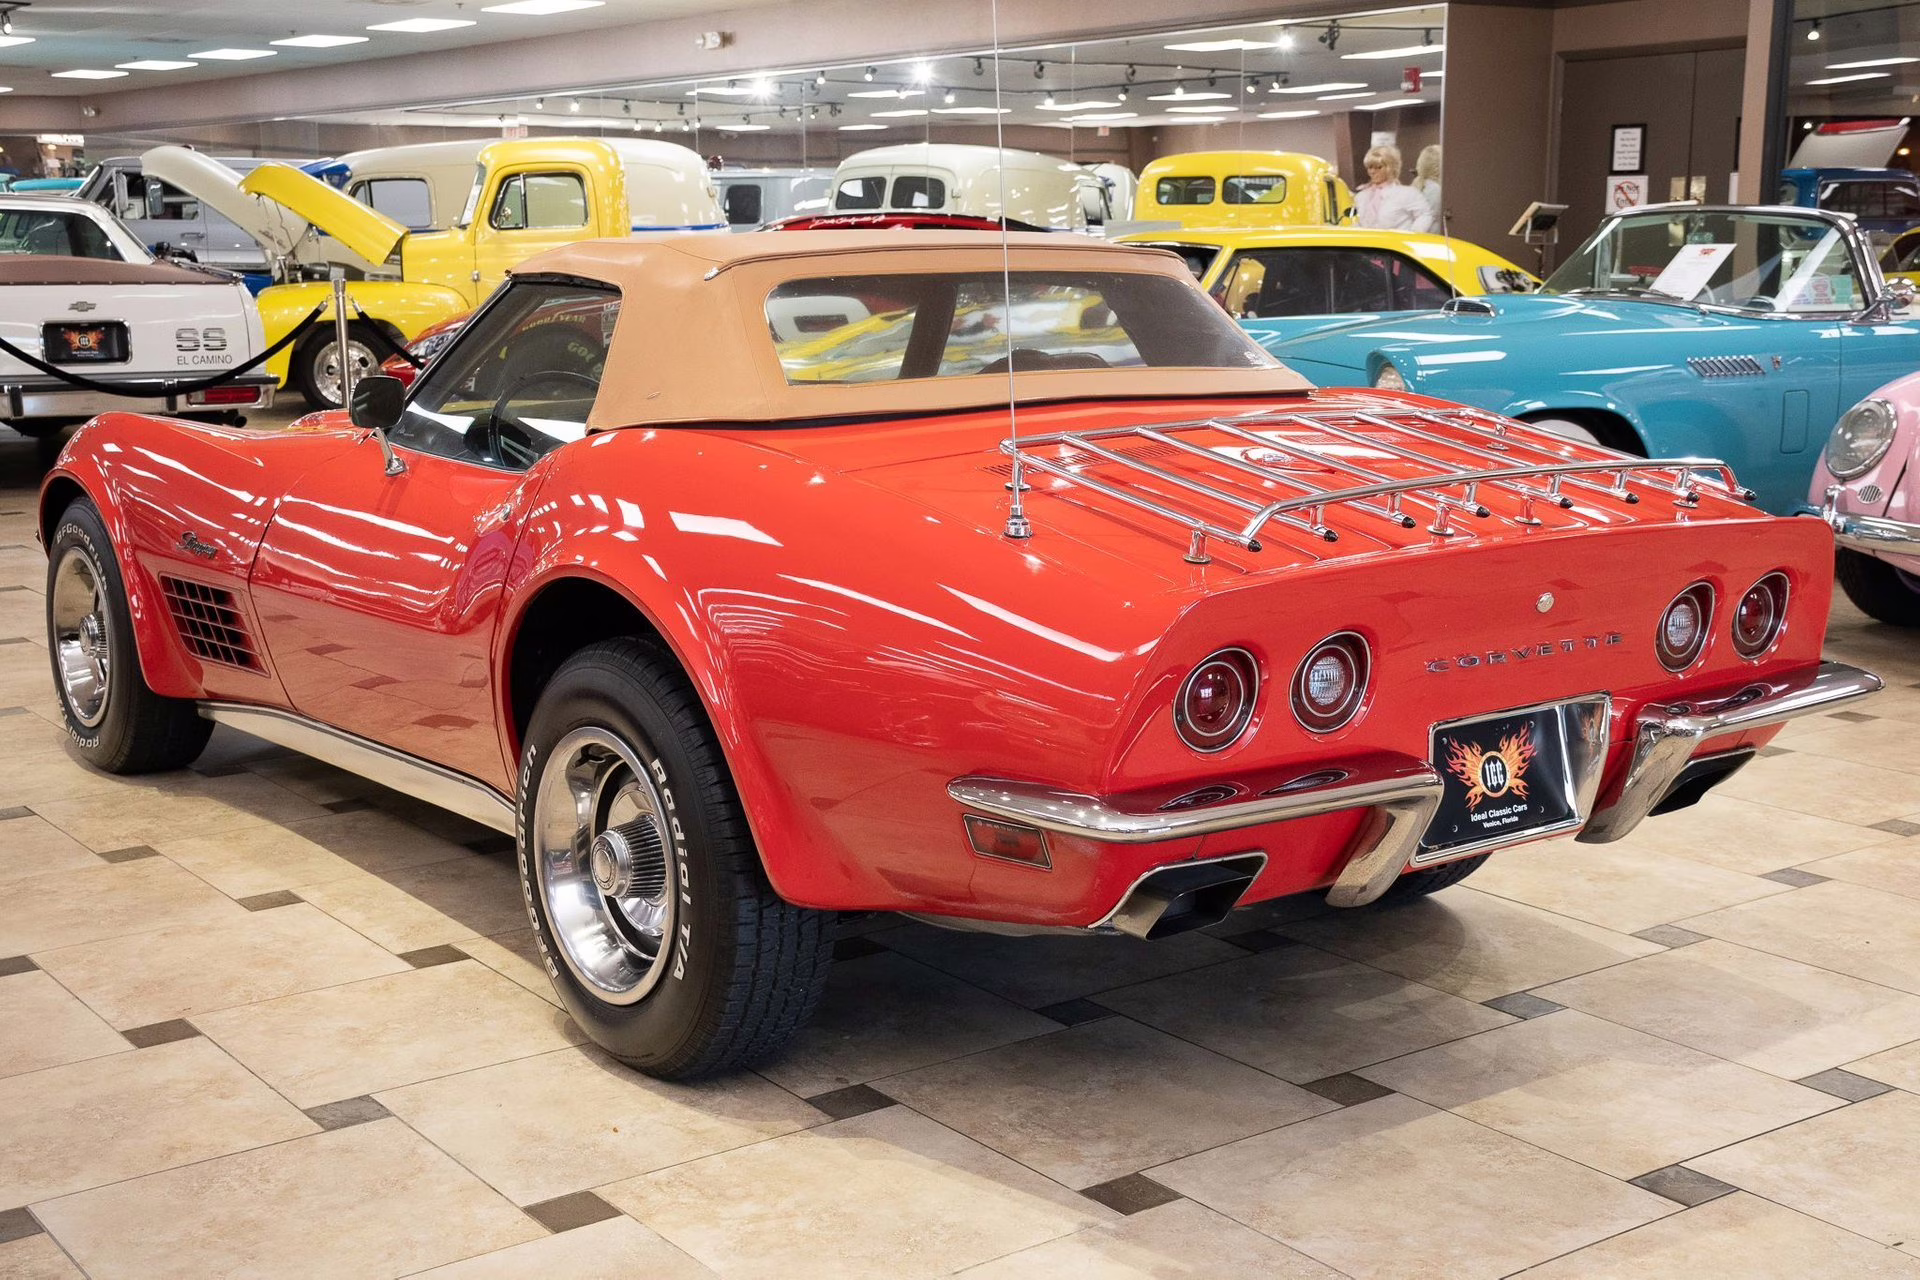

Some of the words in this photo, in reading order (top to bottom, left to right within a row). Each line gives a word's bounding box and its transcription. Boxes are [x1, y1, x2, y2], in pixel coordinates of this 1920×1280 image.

[176, 328, 227, 351] SS
[177, 355, 189, 365] EL
[192, 354, 232, 365] CAMINO
[1425, 631, 1624, 673] CORVETTE
[1470, 811, 1488, 822] Ideal
[1488, 806, 1512, 818] Classic
[1512, 804, 1528, 813] Cars
[1502, 815, 1519, 824] Florida
[651, 758, 691, 905] Radial
[673, 924, 691, 980] T/A
